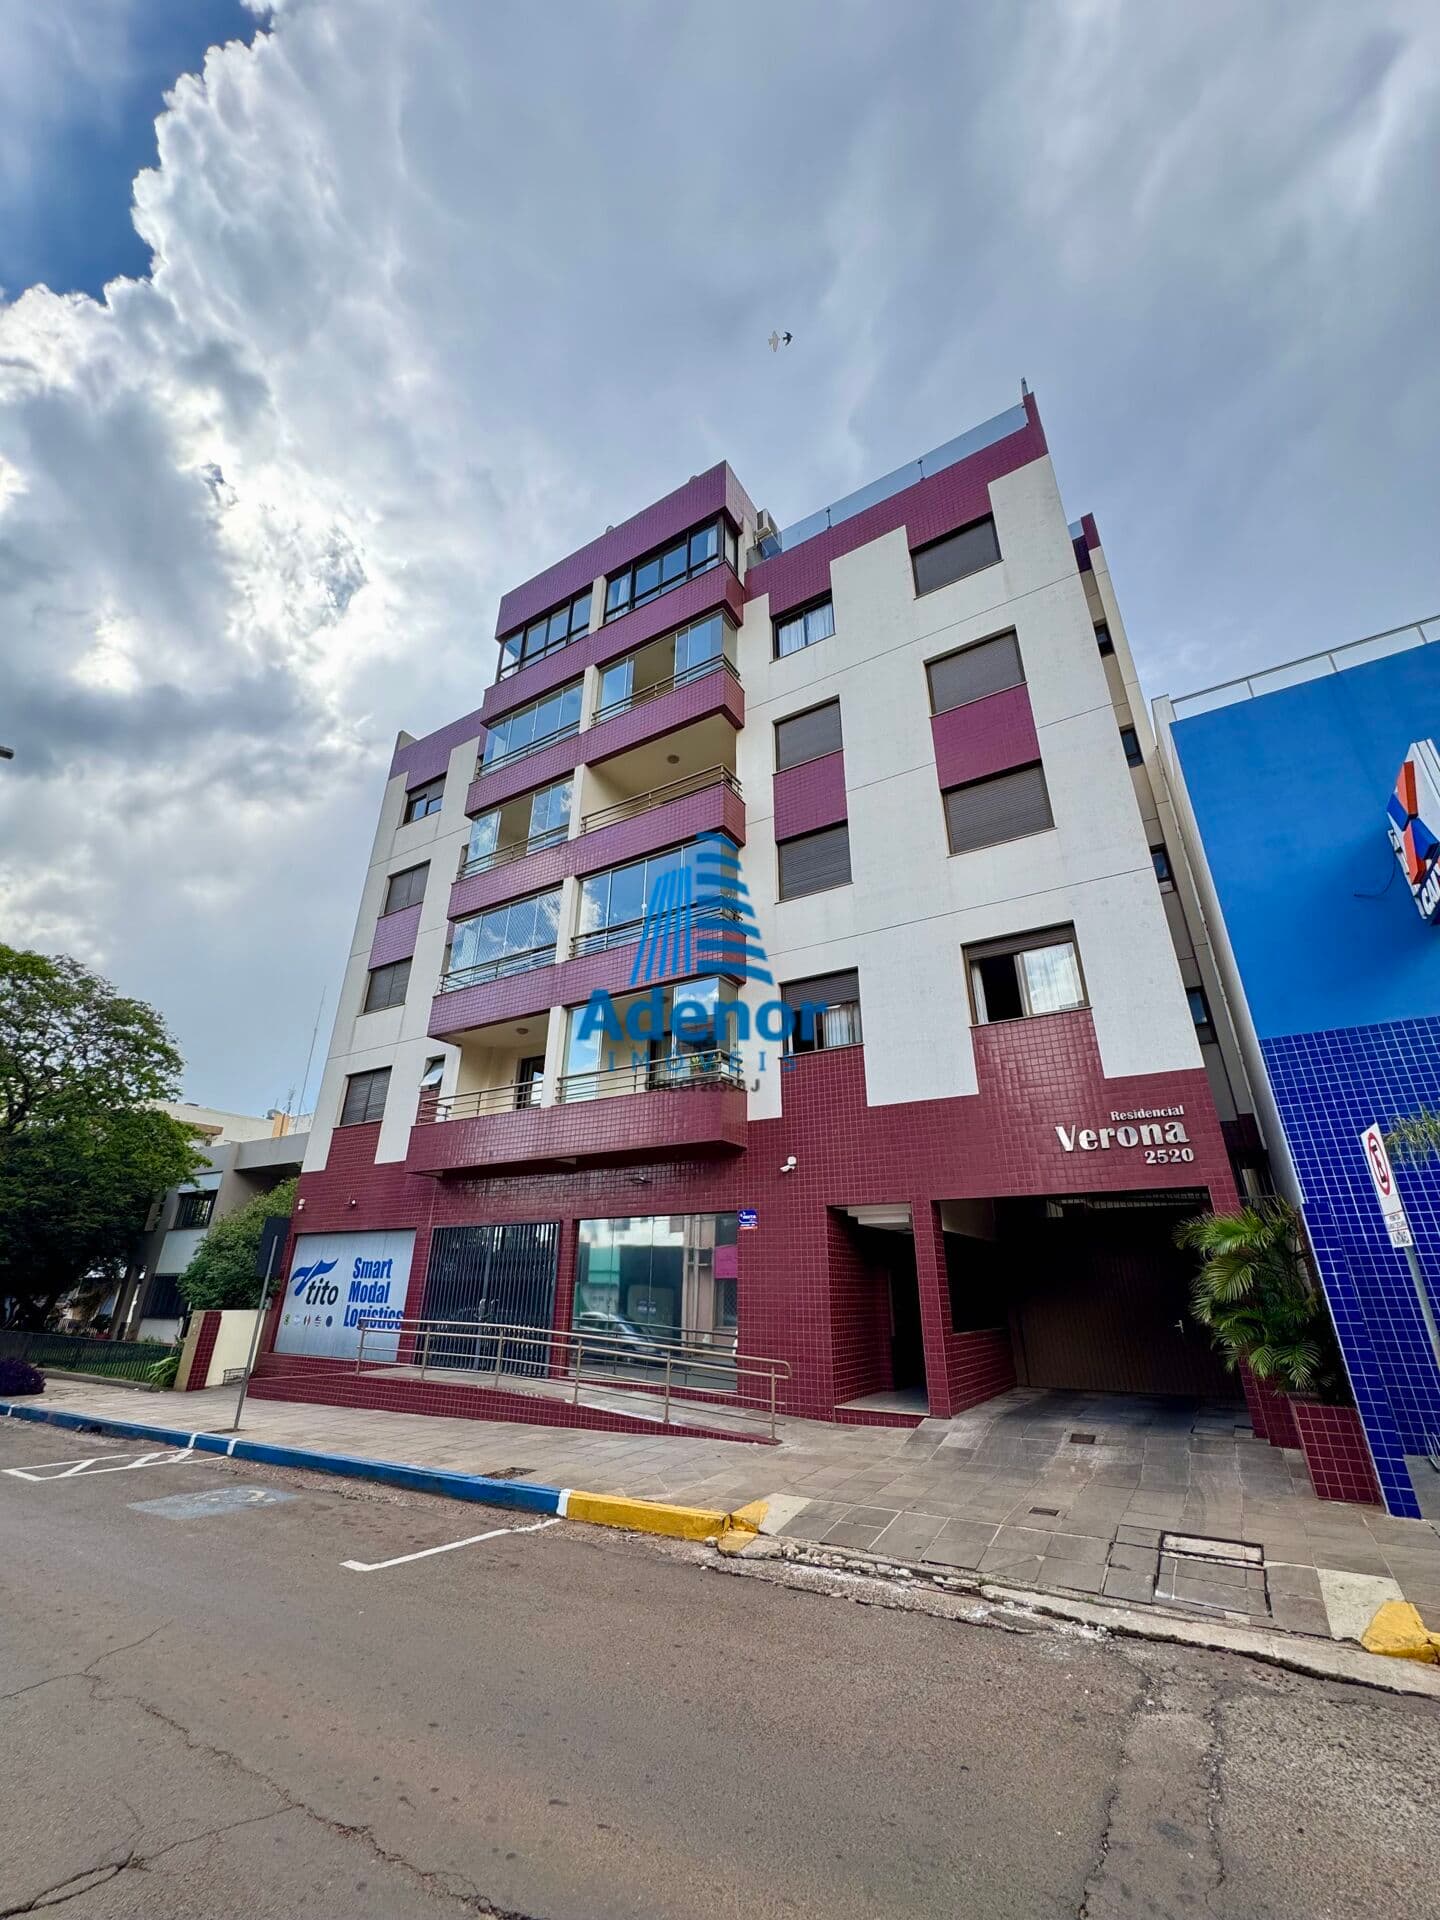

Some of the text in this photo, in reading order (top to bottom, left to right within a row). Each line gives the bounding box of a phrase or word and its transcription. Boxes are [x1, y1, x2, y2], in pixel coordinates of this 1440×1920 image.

[1110, 1105, 1185, 1121] Residencial
[1055, 1121, 1190, 1152] Verona
[1144, 1147, 1194, 1164] 2520
[352, 1257, 393, 1279] Smart
[305, 1278, 339, 1305] tito
[348, 1281, 391, 1303] Modal
